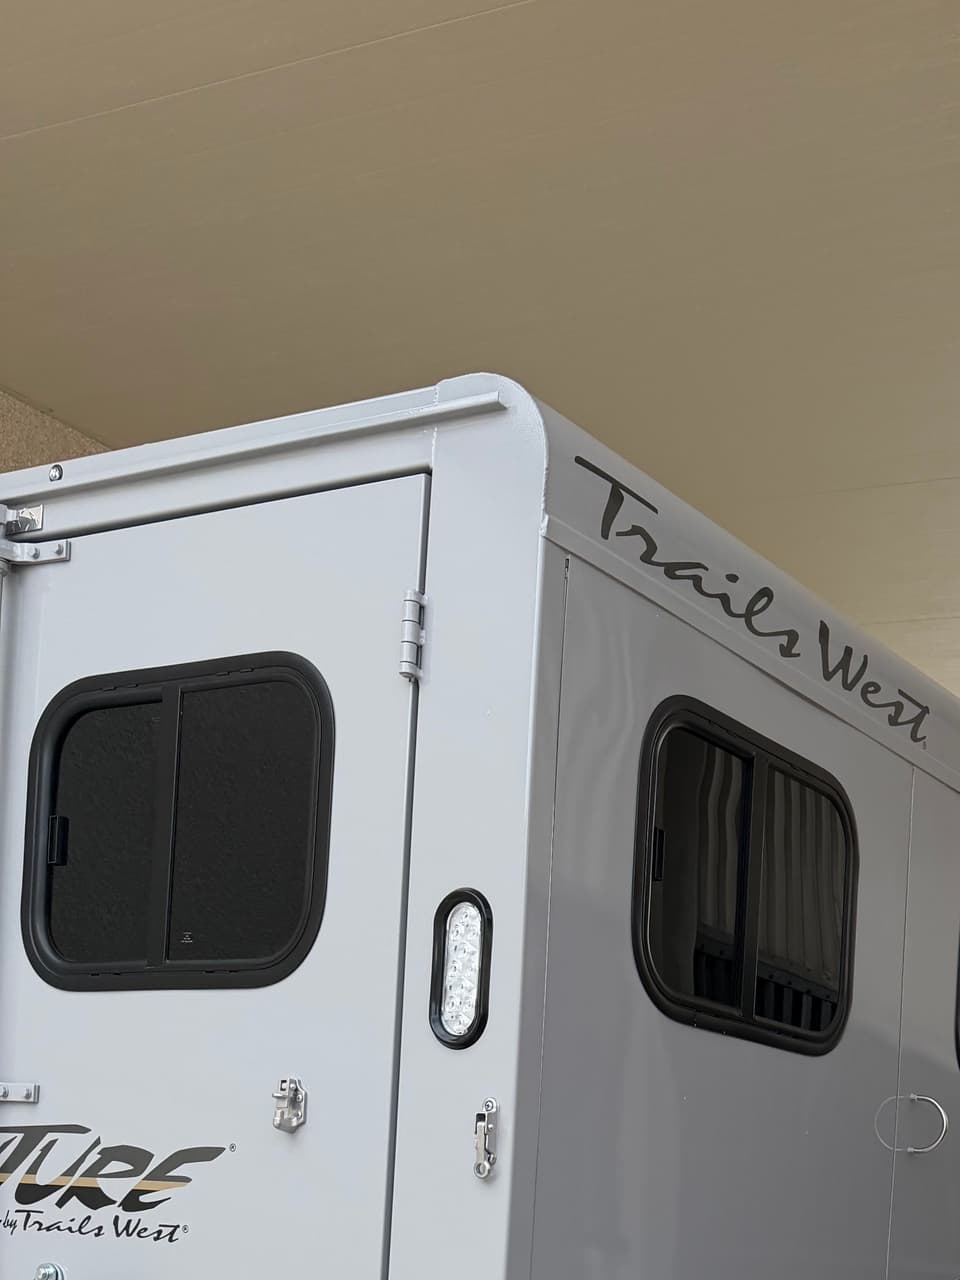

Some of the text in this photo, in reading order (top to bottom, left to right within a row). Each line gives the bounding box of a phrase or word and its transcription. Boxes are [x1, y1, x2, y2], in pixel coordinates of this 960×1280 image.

[574, 455, 930, 742] Trails West
[0, 1123, 226, 1212] TURE
[2, 1209, 181, 1243] by Trails West
